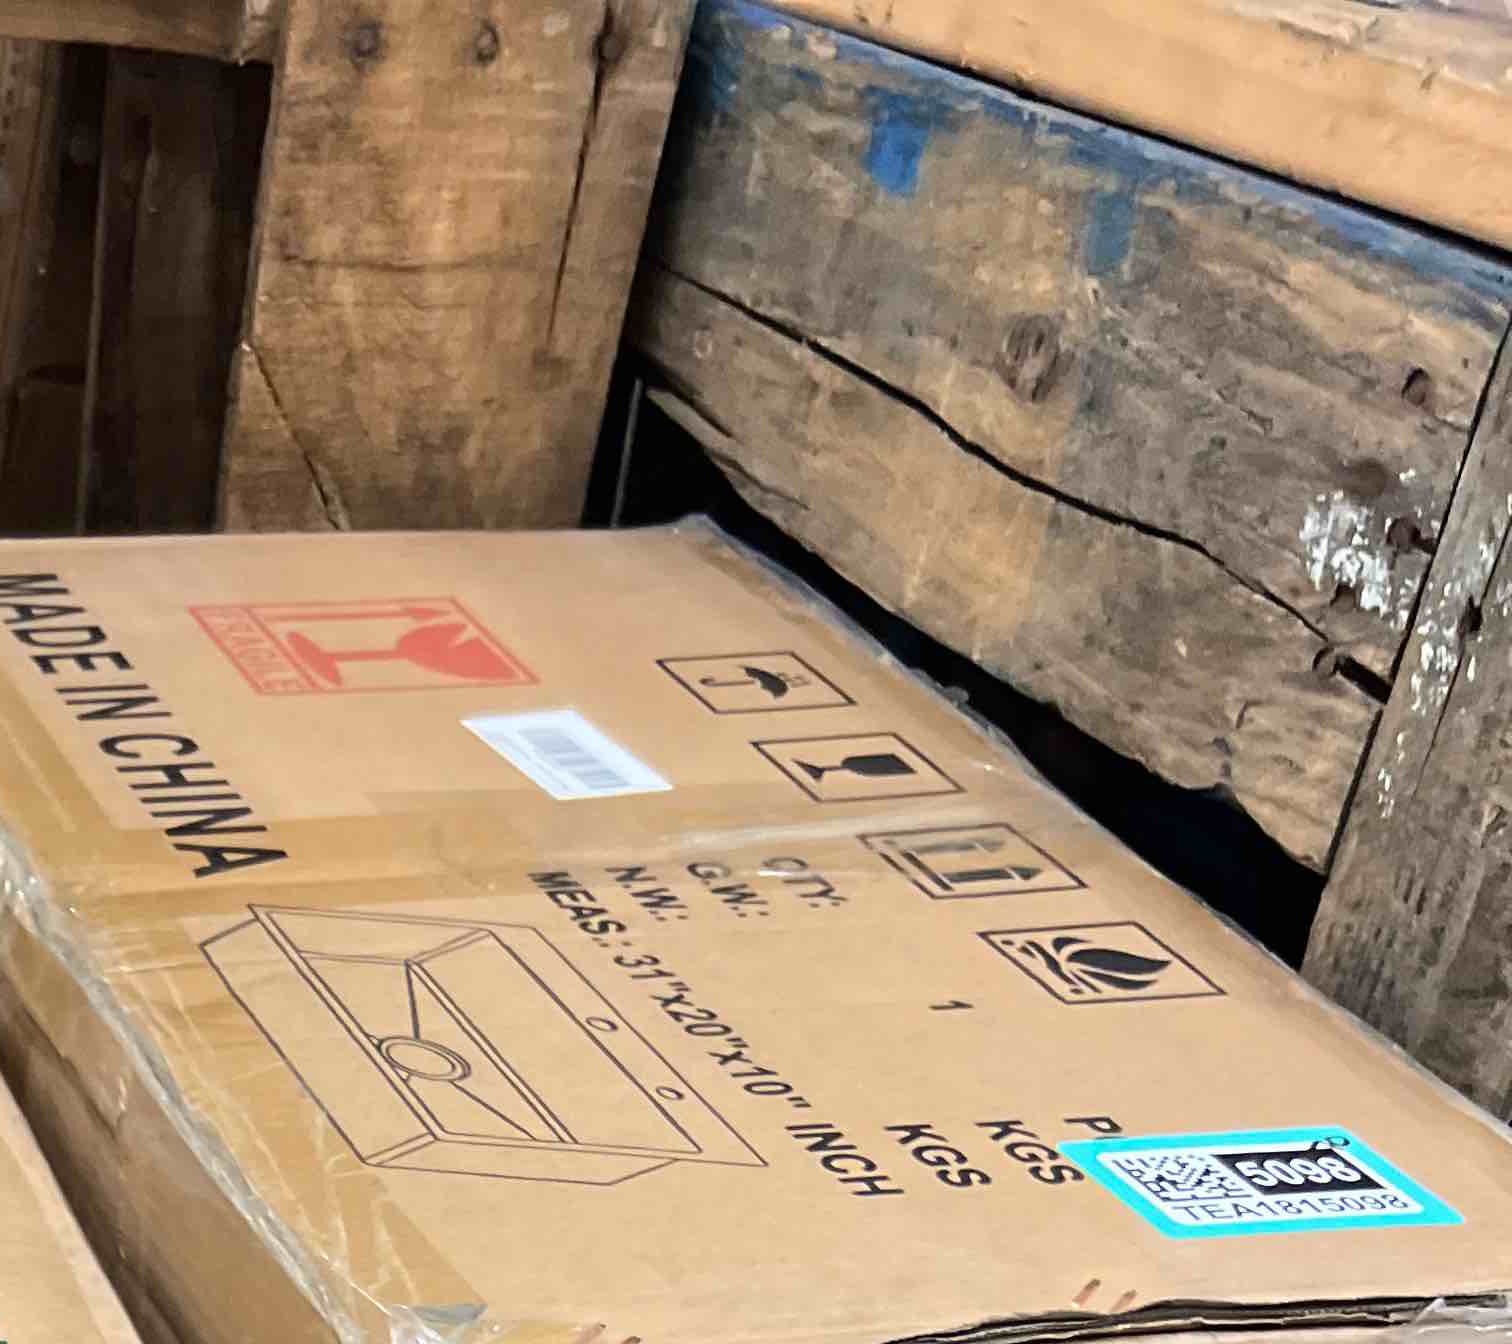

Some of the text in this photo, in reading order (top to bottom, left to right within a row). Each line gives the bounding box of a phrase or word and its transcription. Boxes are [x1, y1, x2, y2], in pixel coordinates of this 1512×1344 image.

[55, 684, 173, 722] IN
[98, 733, 290, 879] CHINA
[928, 999, 975, 1012] 1
[784, 1122, 905, 1197] INCH
[884, 1123, 993, 1188] KGS
[974, 1119, 1086, 1185] KGS
[1234, 1155, 1362, 1188] 5098
[1170, 1194, 1410, 1225] TEA1815098
